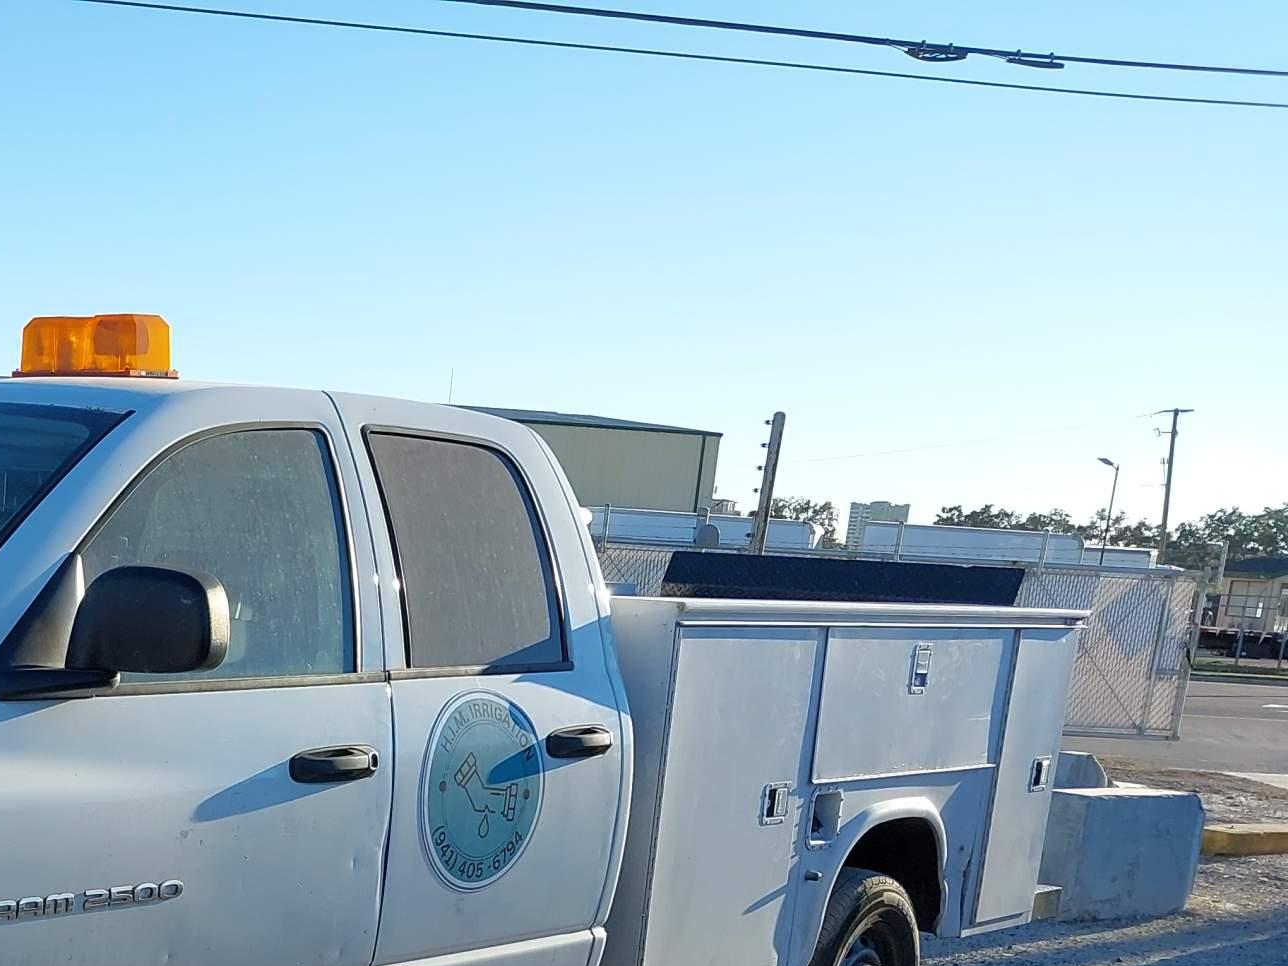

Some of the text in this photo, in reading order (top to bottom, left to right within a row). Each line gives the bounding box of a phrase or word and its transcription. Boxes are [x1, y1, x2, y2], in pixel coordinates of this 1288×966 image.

[440, 702, 535, 762] H.I.M. IRRIGATION
[431, 825, 458, 871] (941)
[82, 879, 185, 914] 2500
